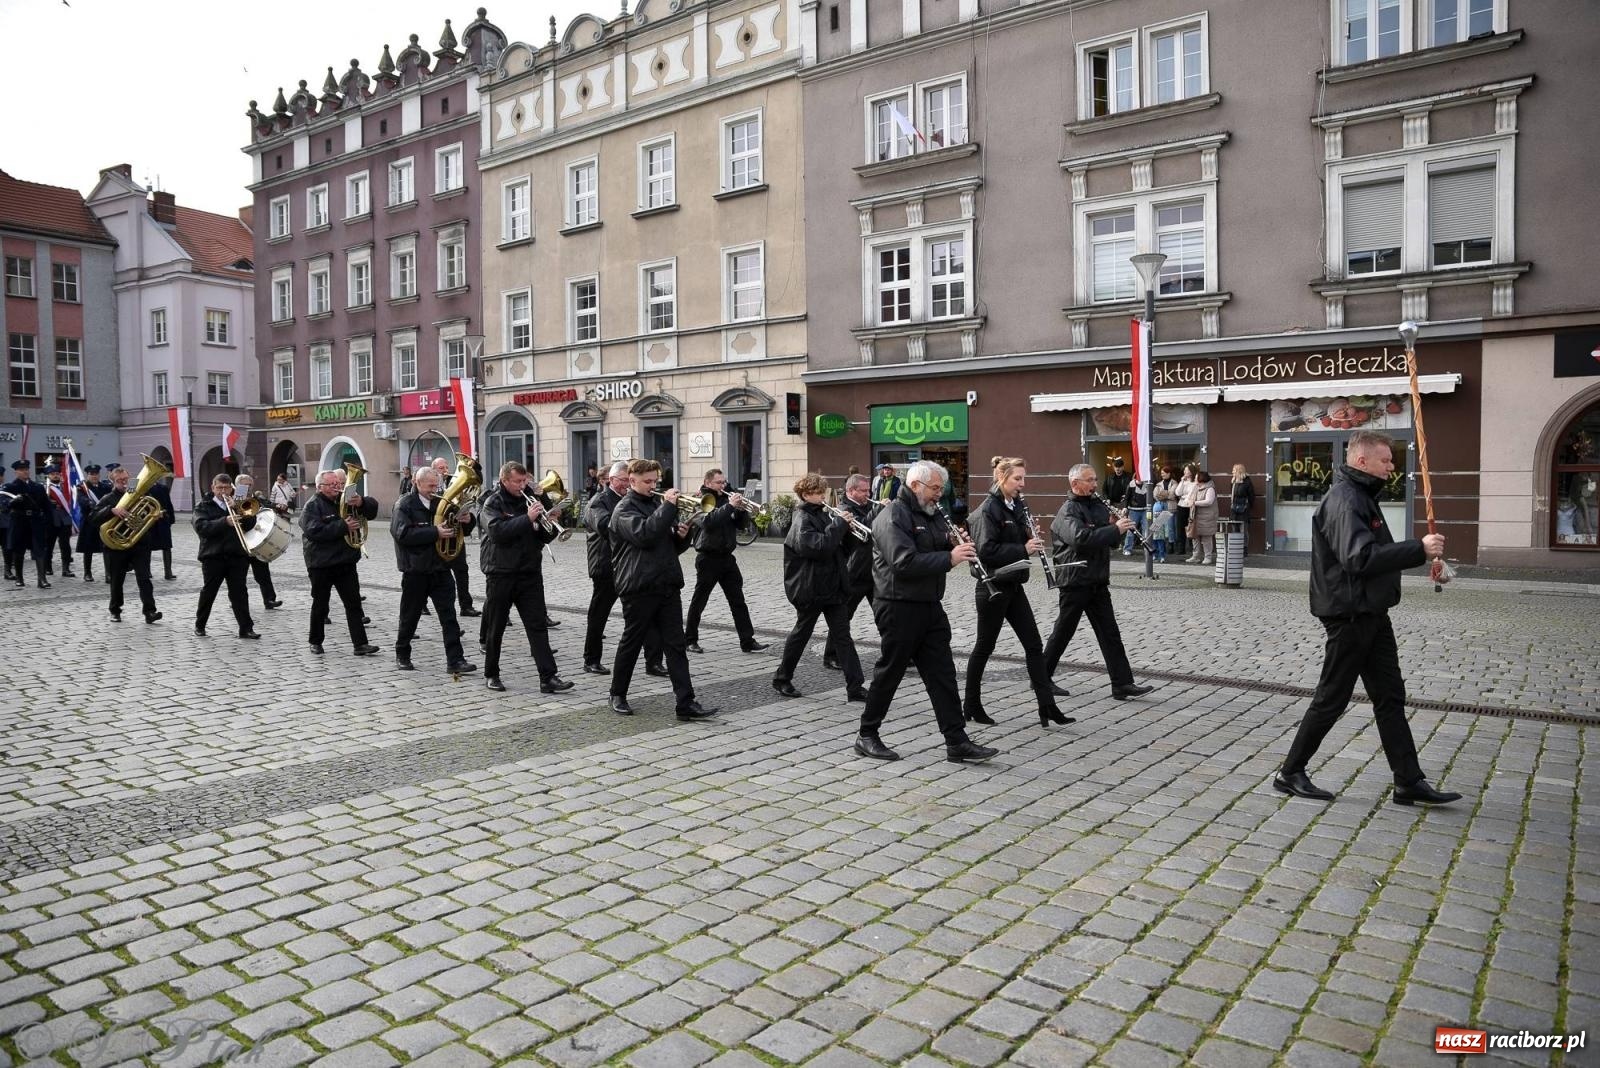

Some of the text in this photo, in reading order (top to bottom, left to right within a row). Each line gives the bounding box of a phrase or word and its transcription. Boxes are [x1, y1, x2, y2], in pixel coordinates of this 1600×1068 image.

[1093, 347, 1408, 388] Manaktura Lodów Gałeczka
[514, 389, 578, 405] RESTAURACJA
[596, 380, 642, 401] SHIRO
[266, 407, 300, 419] TABAC
[315, 401, 367, 421] KANTOR
[822, 419, 845, 430] żabka
[883, 411, 954, 435] żabka
